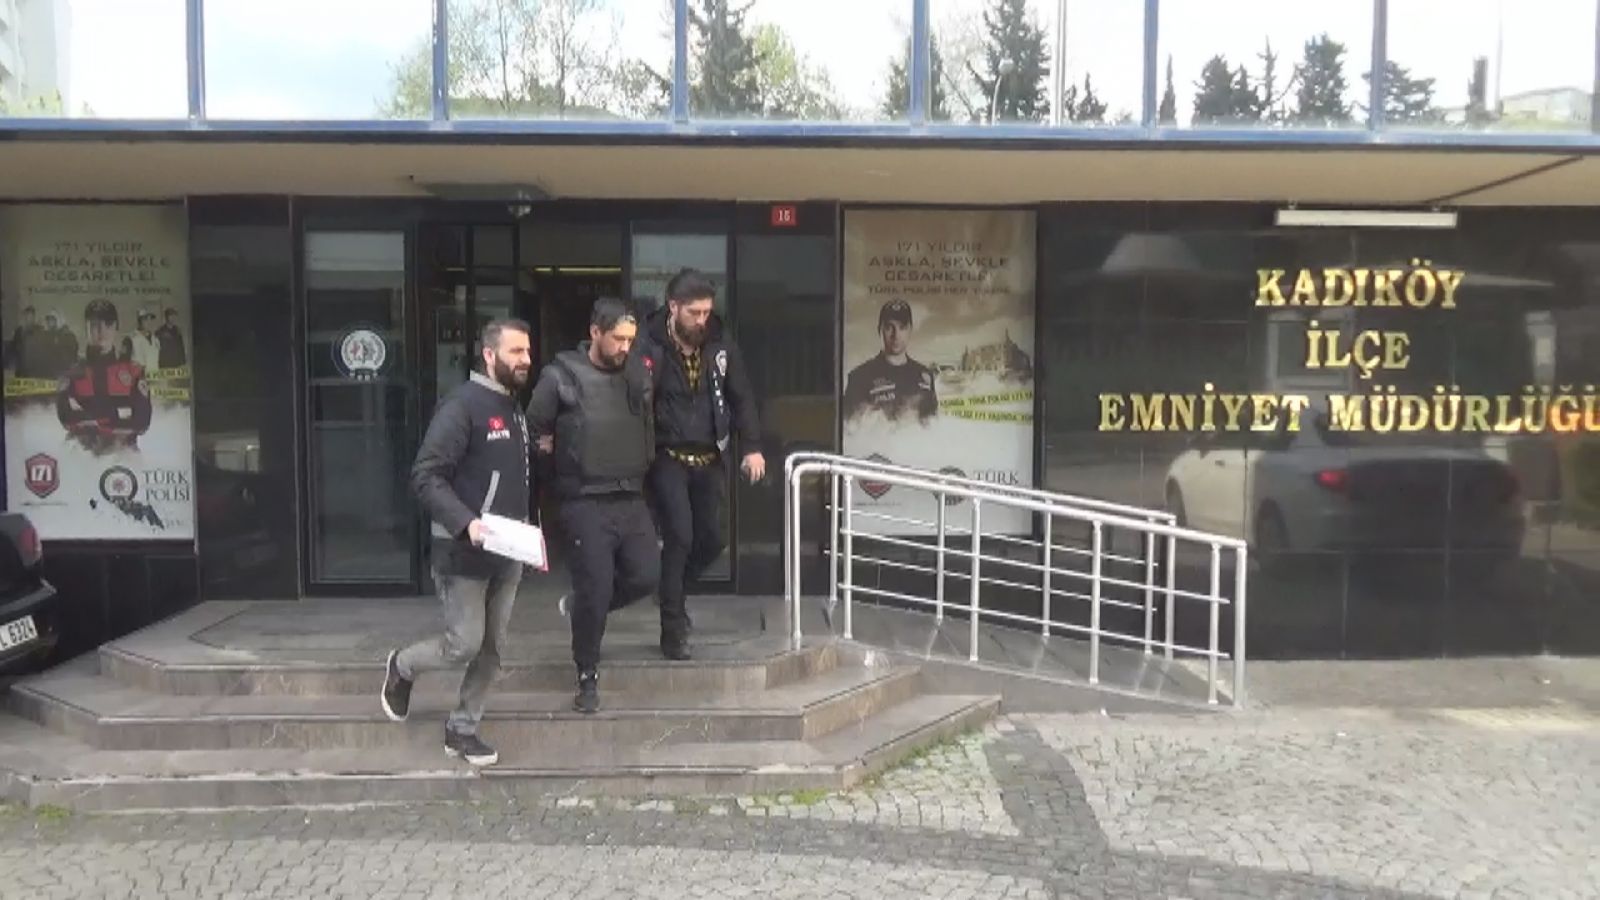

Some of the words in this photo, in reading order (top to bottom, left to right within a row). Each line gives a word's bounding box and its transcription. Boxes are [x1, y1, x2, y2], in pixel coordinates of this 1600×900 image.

[1254, 257, 1465, 308] KADIKÖY
[1304, 319, 1411, 380] İLÇE
[1098, 381, 1311, 432] EMNİYET
[31, 464, 52, 481] 171
[143, 468, 188, 484] TÜRK
[973, 467, 1019, 485] TÜRK
